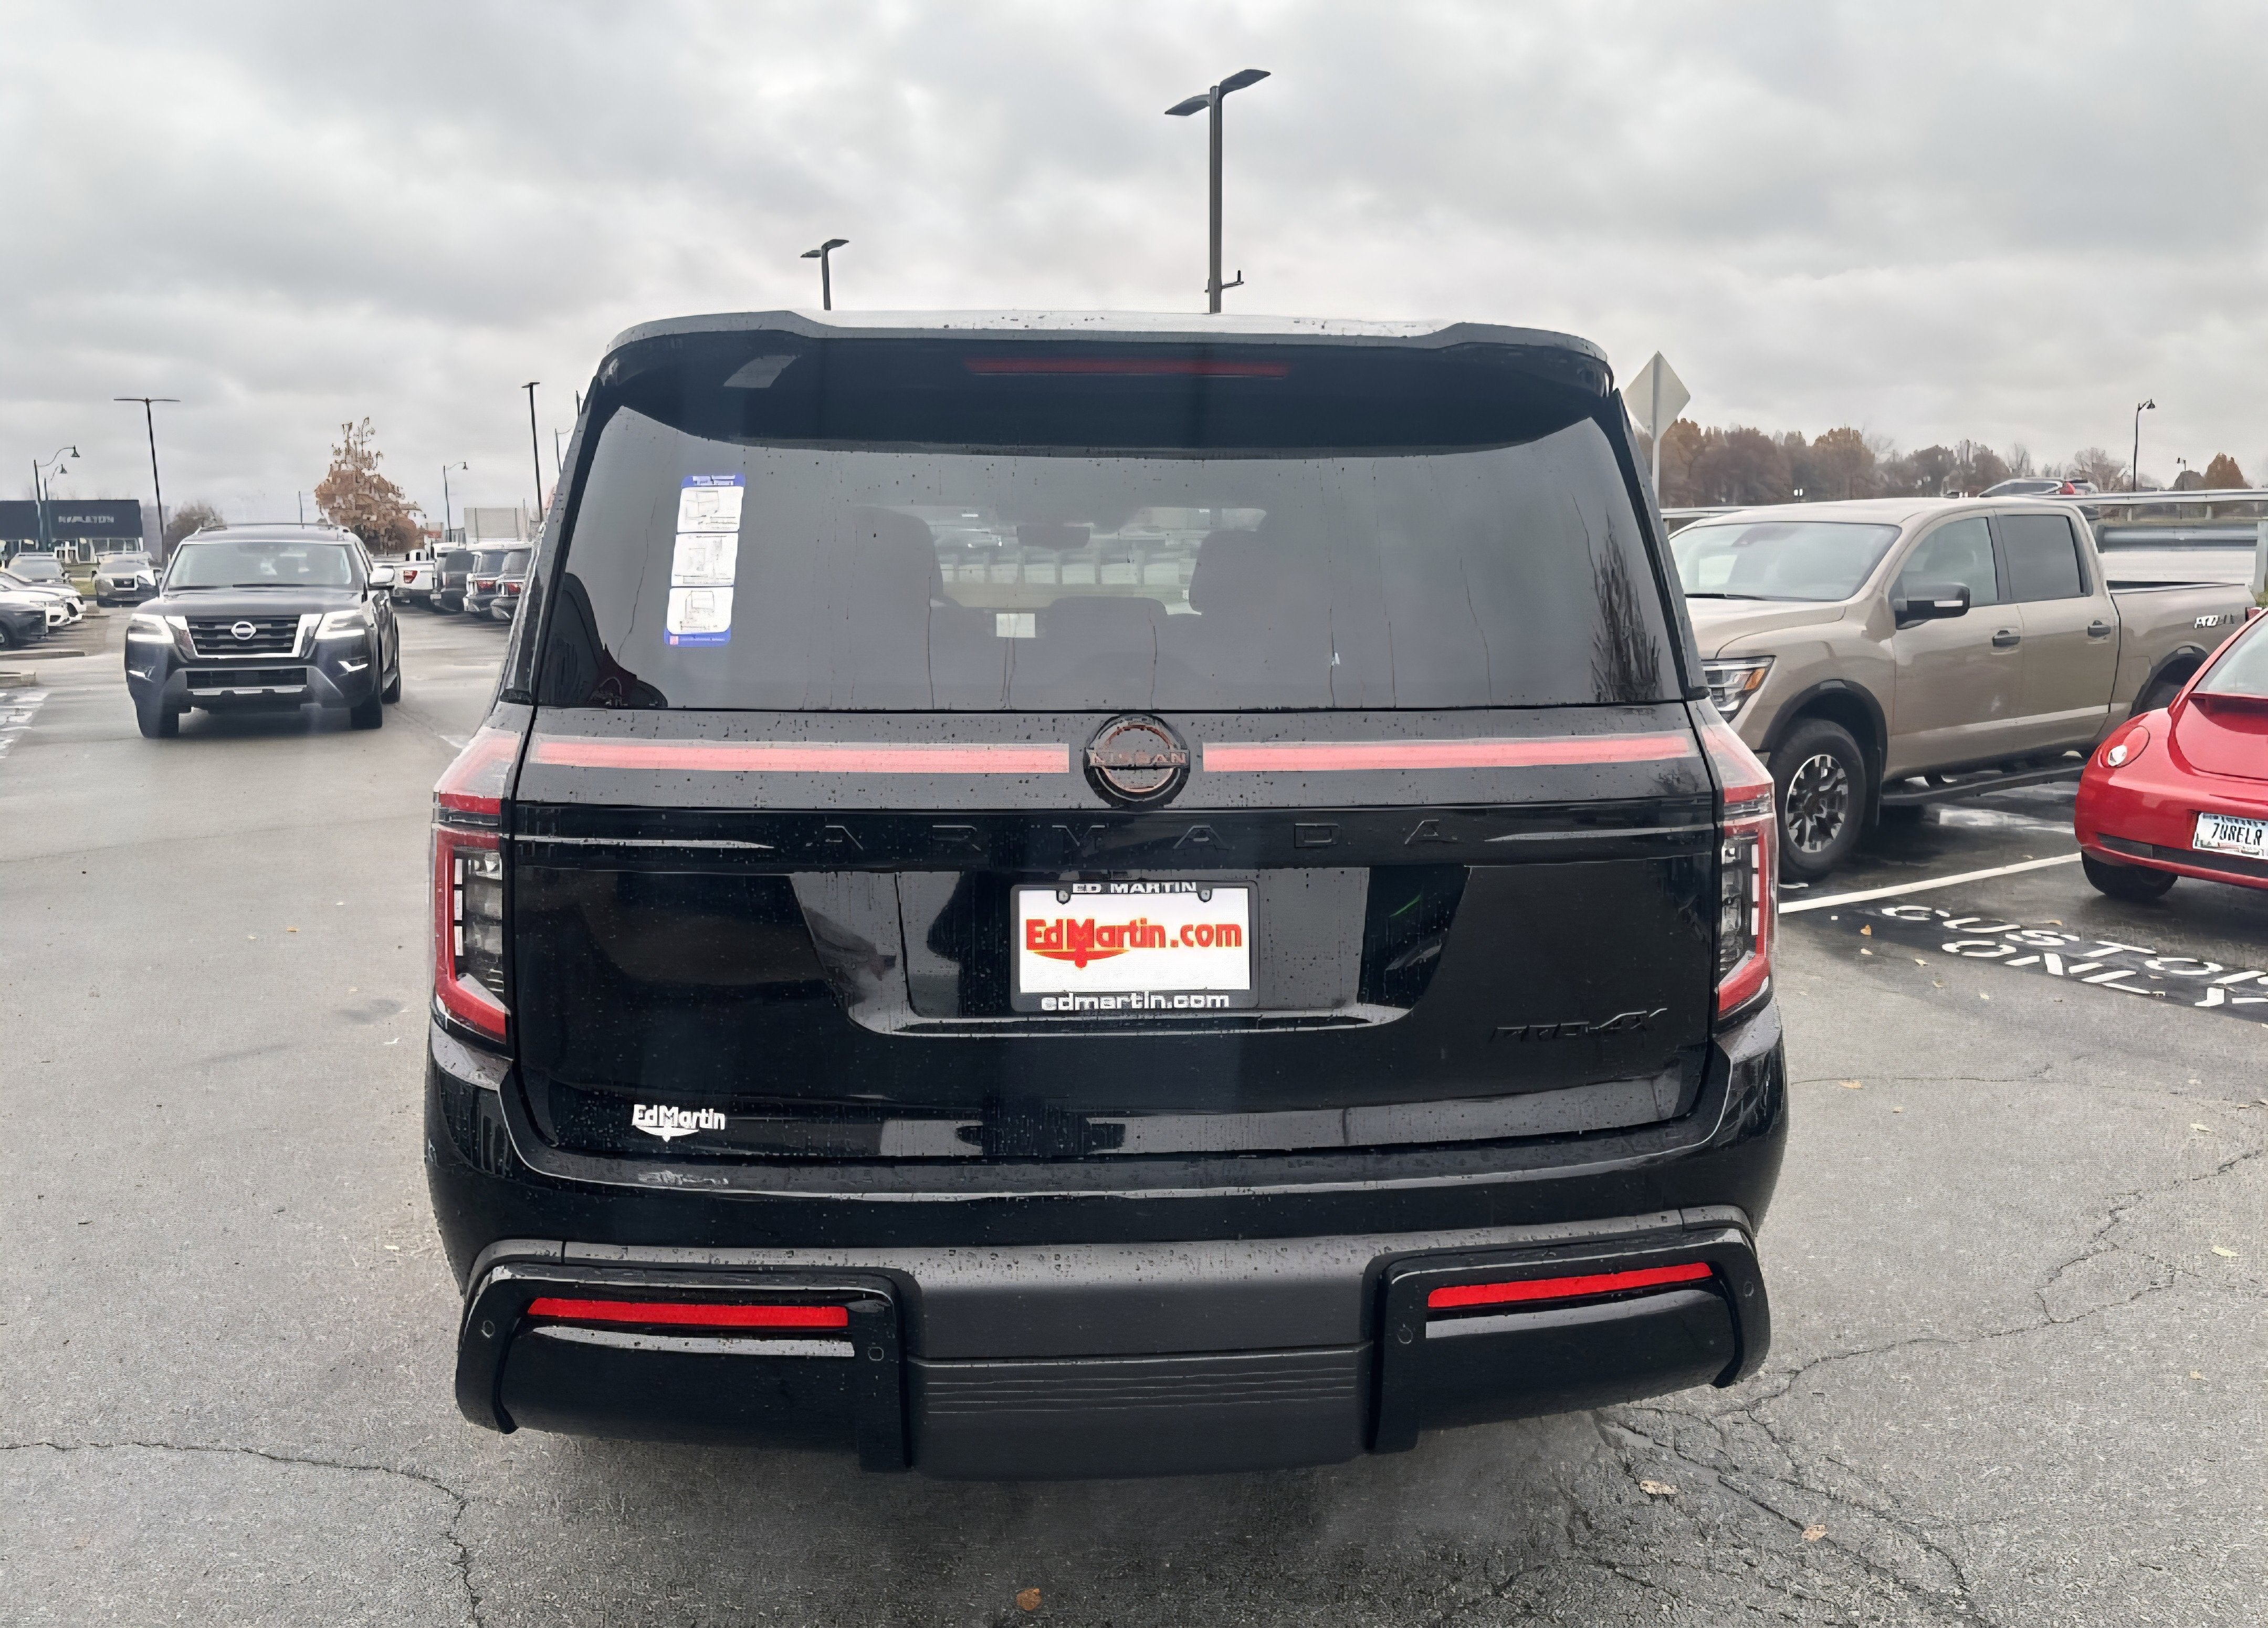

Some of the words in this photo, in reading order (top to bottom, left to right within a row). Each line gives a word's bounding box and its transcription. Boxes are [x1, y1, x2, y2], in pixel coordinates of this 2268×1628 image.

[1072, 883, 1101, 893] ED
[1110, 881, 1196, 893] MARTIN
[1026, 917, 1242, 950] EdMartin.com
[1041, 990, 1230, 1011] edmartin.com
[632, 1104, 726, 1130] EdMartin
